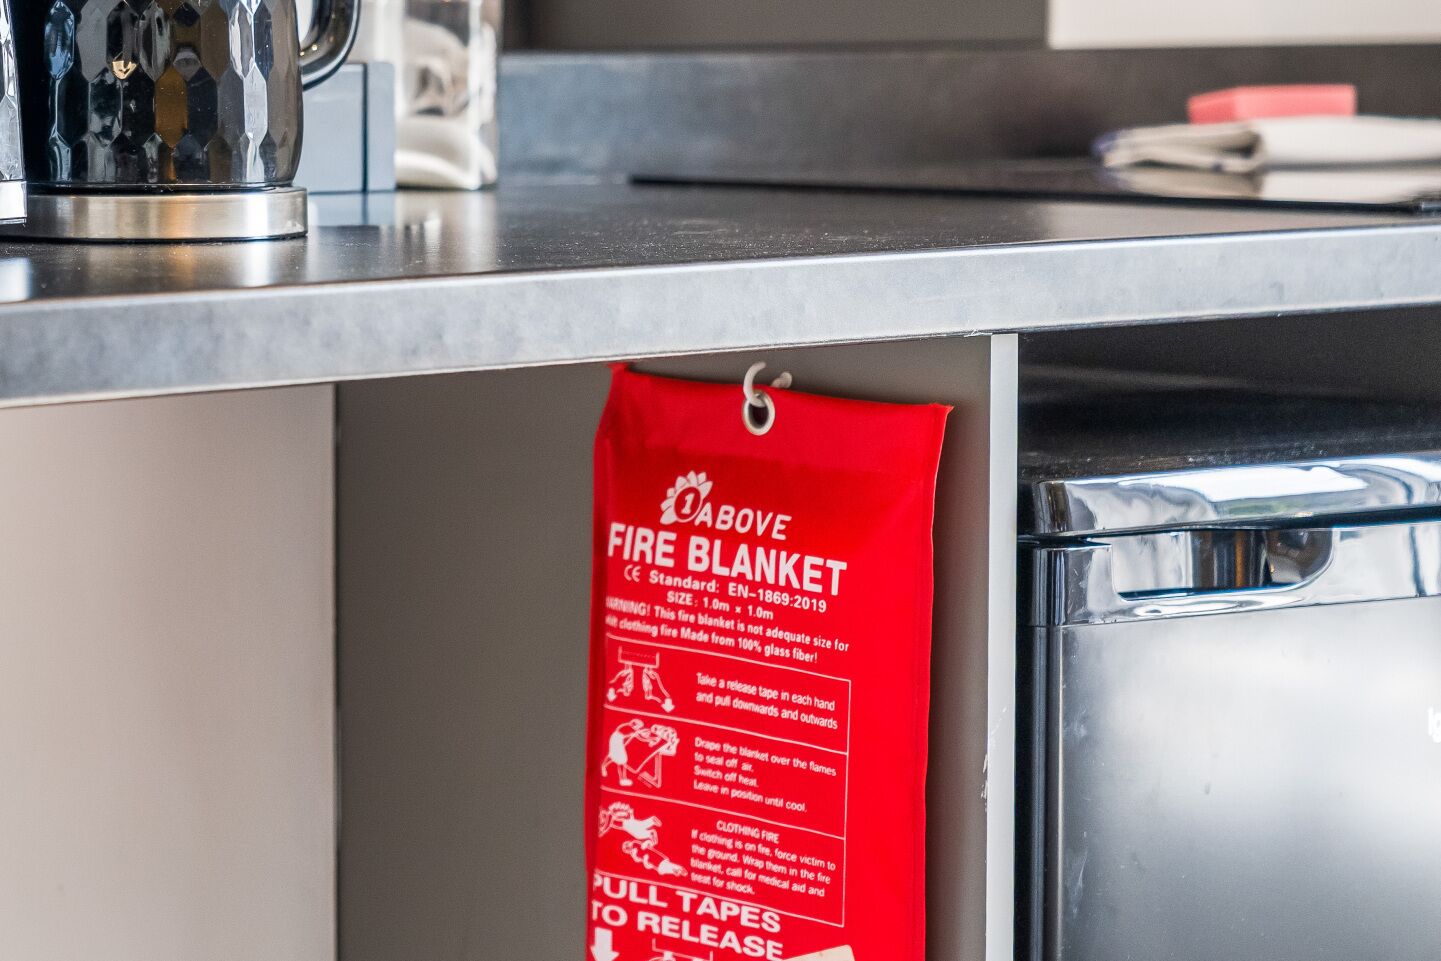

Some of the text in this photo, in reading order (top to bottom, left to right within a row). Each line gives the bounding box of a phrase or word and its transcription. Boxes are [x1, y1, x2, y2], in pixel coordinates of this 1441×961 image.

[694, 502, 792, 540] ABOVE
[608, 522, 848, 597] FIRE BLANKET
[649, 569, 720, 594] Standard:
[654, 605, 675, 620] This
[678, 610, 695, 623] fire
[698, 613, 735, 630] blanket
[737, 619, 745, 632] is
[747, 624, 763, 635] not
[766, 627, 810, 645] adequate
[813, 635, 832, 648] size
[834, 639, 849, 652] for
[703, 597, 729, 612] 1.0m
[748, 605, 774, 621] 1.0m
[619, 618, 658, 638] clothing
[660, 624, 678, 638] fire
[680, 627, 709, 642] Made
[711, 632, 735, 647] from
[738, 637, 762, 653] 100%
[764, 643, 790, 658] glass
[696, 672, 836, 711] Take a release tape in each hand
[696, 691, 838, 730] and pull downwards and outwards
[694, 737, 837, 777] Drape the blanket over the flames
[694, 752, 704, 762] to
[706, 754, 724, 765] seal
[725, 758, 738, 768] off
[694, 765, 723, 779] Switch
[724, 771, 737, 782] off
[693, 779, 719, 793] Leave
[720, 786, 729, 795] in
[731, 788, 763, 803] position
[764, 795, 784, 808] until
[716, 820, 780, 844] CLOTHING FIRE
[691, 844, 706, 855] the
[742, 855, 764, 869] Wrap
[765, 860, 787, 874] them
[789, 865, 798, 876] in
[800, 868, 815, 880] the
[817, 872, 831, 884] fire
[699, 832, 733, 849] clothing
[735, 840, 743, 849] is
[744, 843, 756, 851] on
[774, 848, 797, 862] force
[800, 855, 825, 868] victim
[827, 861, 836, 872] to
[690, 872, 711, 885] treat
[712, 876, 724, 888] for
[726, 867, 743, 877] call
[744, 870, 756, 881] for
[758, 874, 790, 889] medical
[791, 882, 806, 893] aid
[808, 886, 825, 897] and
[675, 890, 781, 933] TAPES
[636, 911, 784, 961] RELEASE
